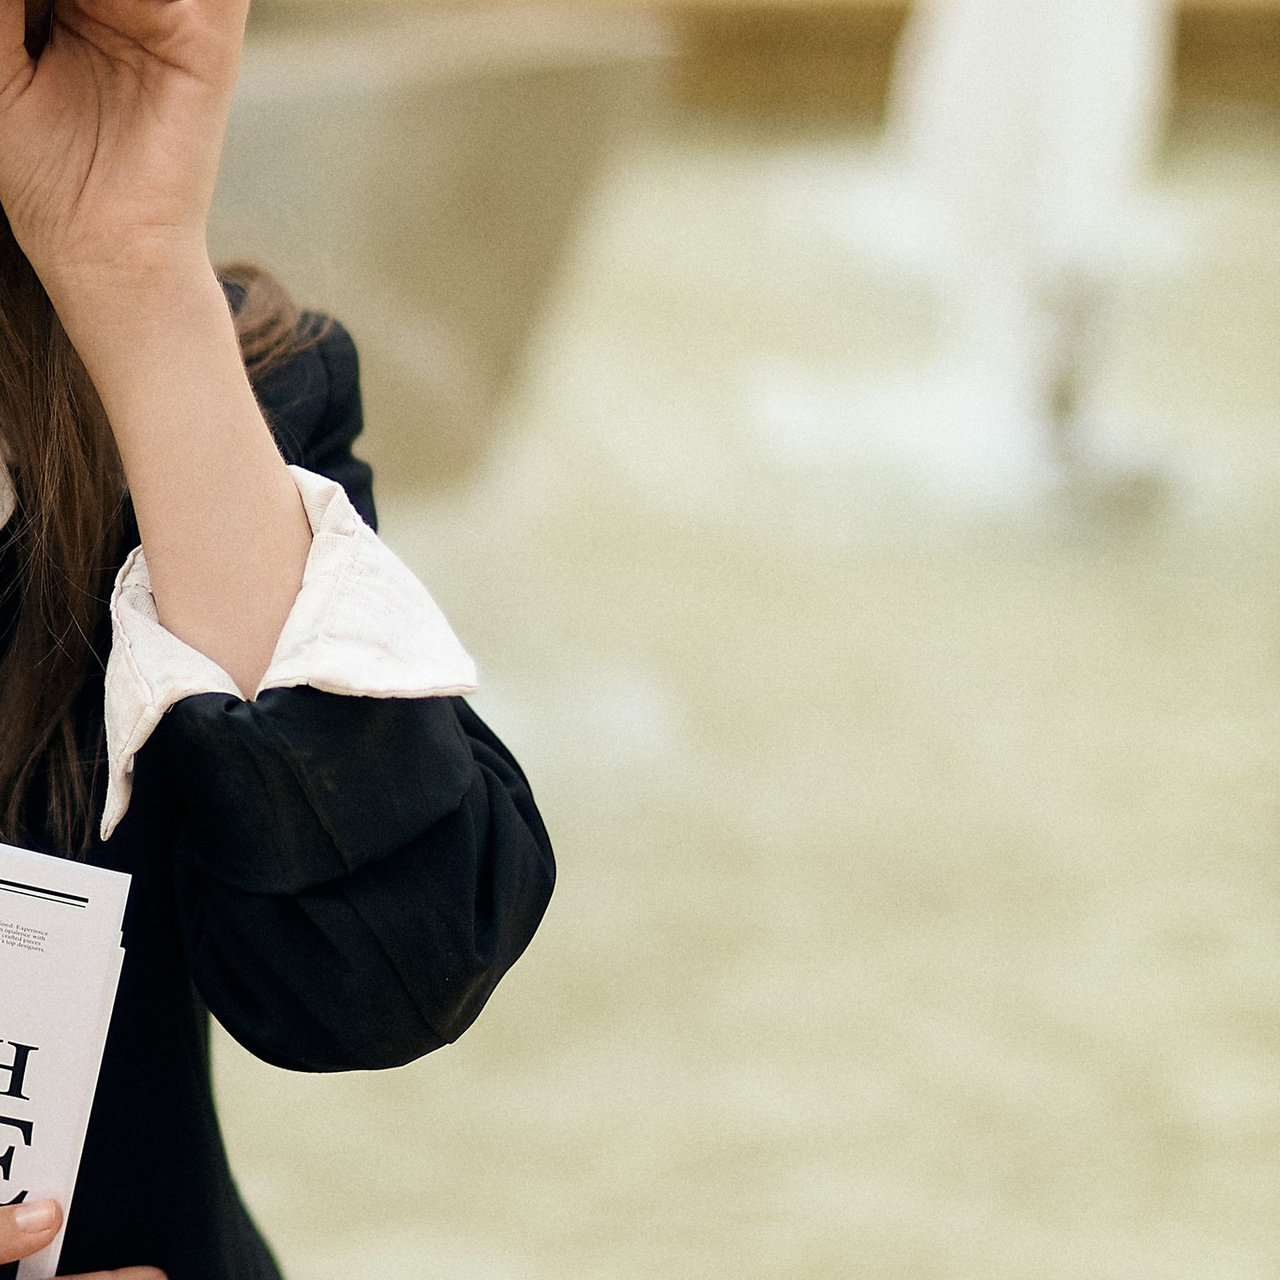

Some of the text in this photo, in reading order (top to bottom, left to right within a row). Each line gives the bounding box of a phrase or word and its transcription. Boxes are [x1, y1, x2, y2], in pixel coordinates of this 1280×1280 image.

[4, 927, 31, 938] opulence
[32, 934, 47, 942] with
[16, 924, 50, 936] Experience
[1, 932, 22, 942] crafted
[23, 937, 41, 946] pieces
[6, 938, 16, 947] top
